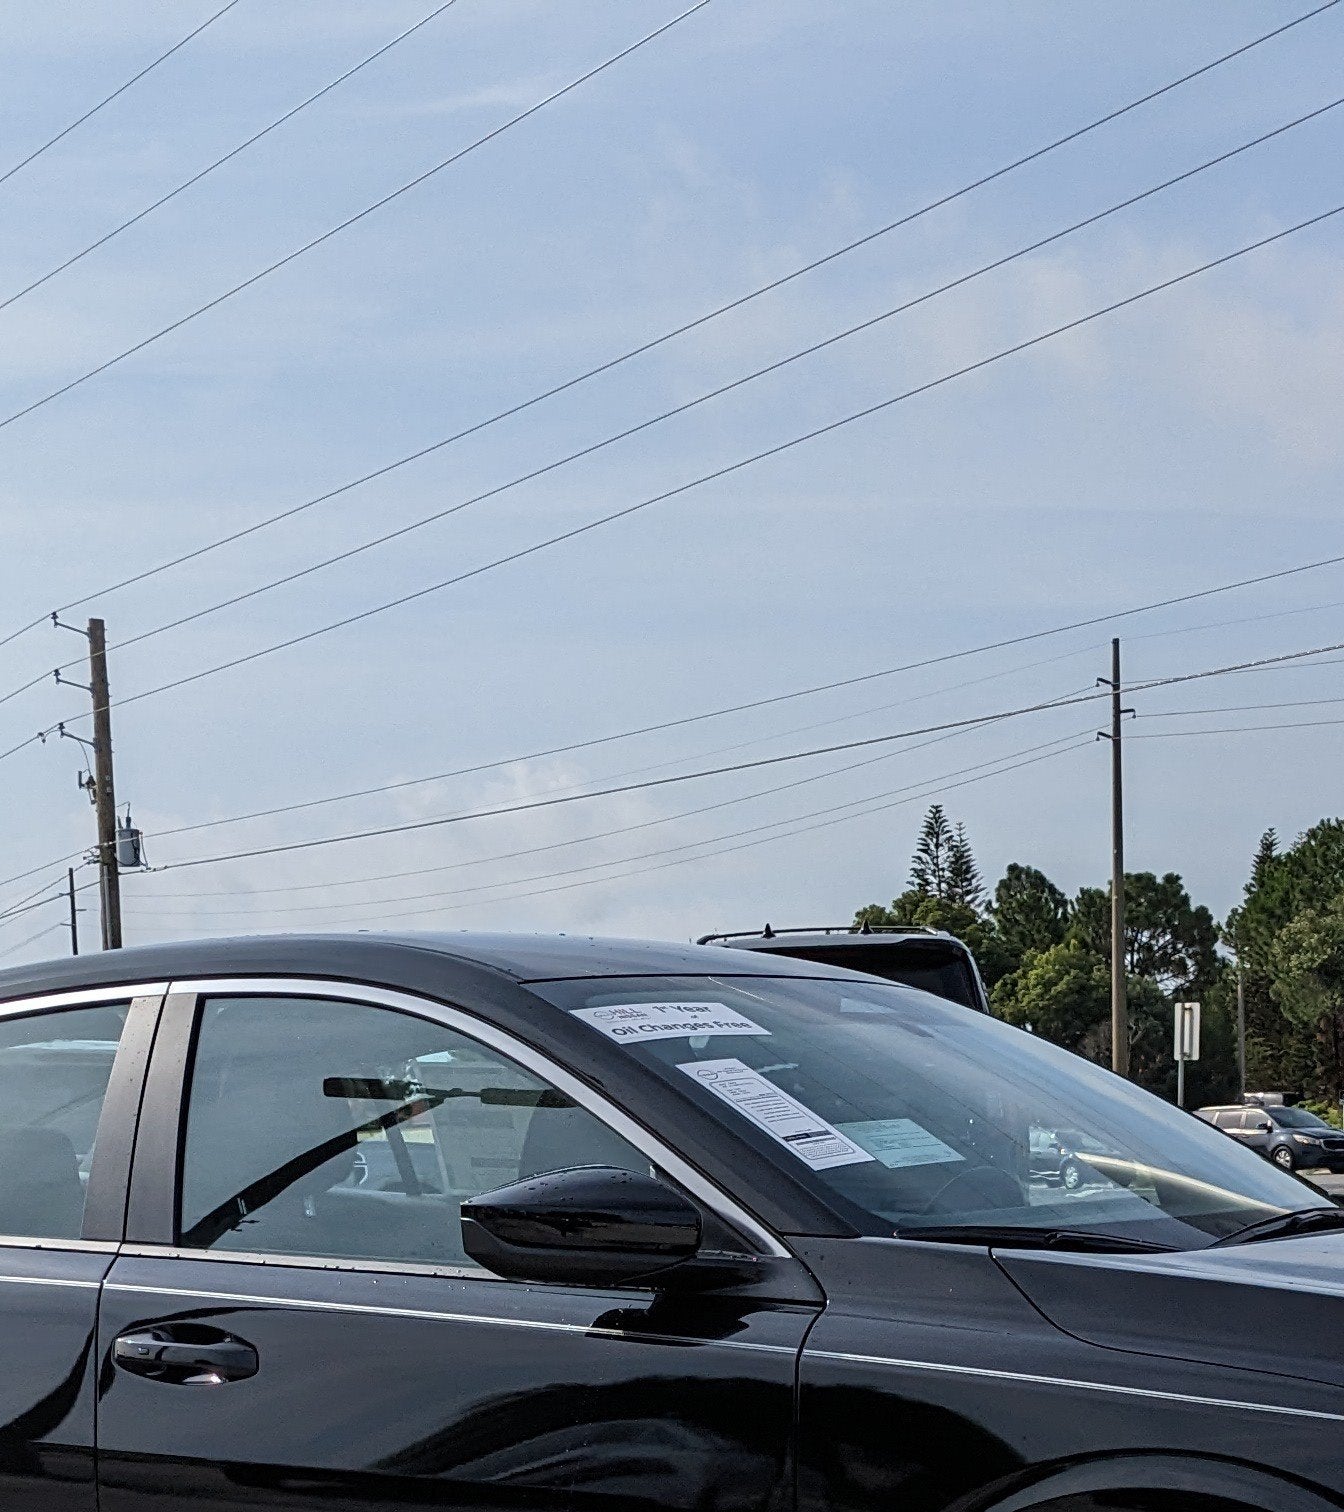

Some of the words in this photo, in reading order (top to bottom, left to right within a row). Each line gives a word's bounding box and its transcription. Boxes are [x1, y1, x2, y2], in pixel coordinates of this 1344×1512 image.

[668, 1005, 712, 1013] Year
[611, 1026, 639, 1036] Oil
[638, 1021, 715, 1033] Changes
[713, 1020, 753, 1030] Free
